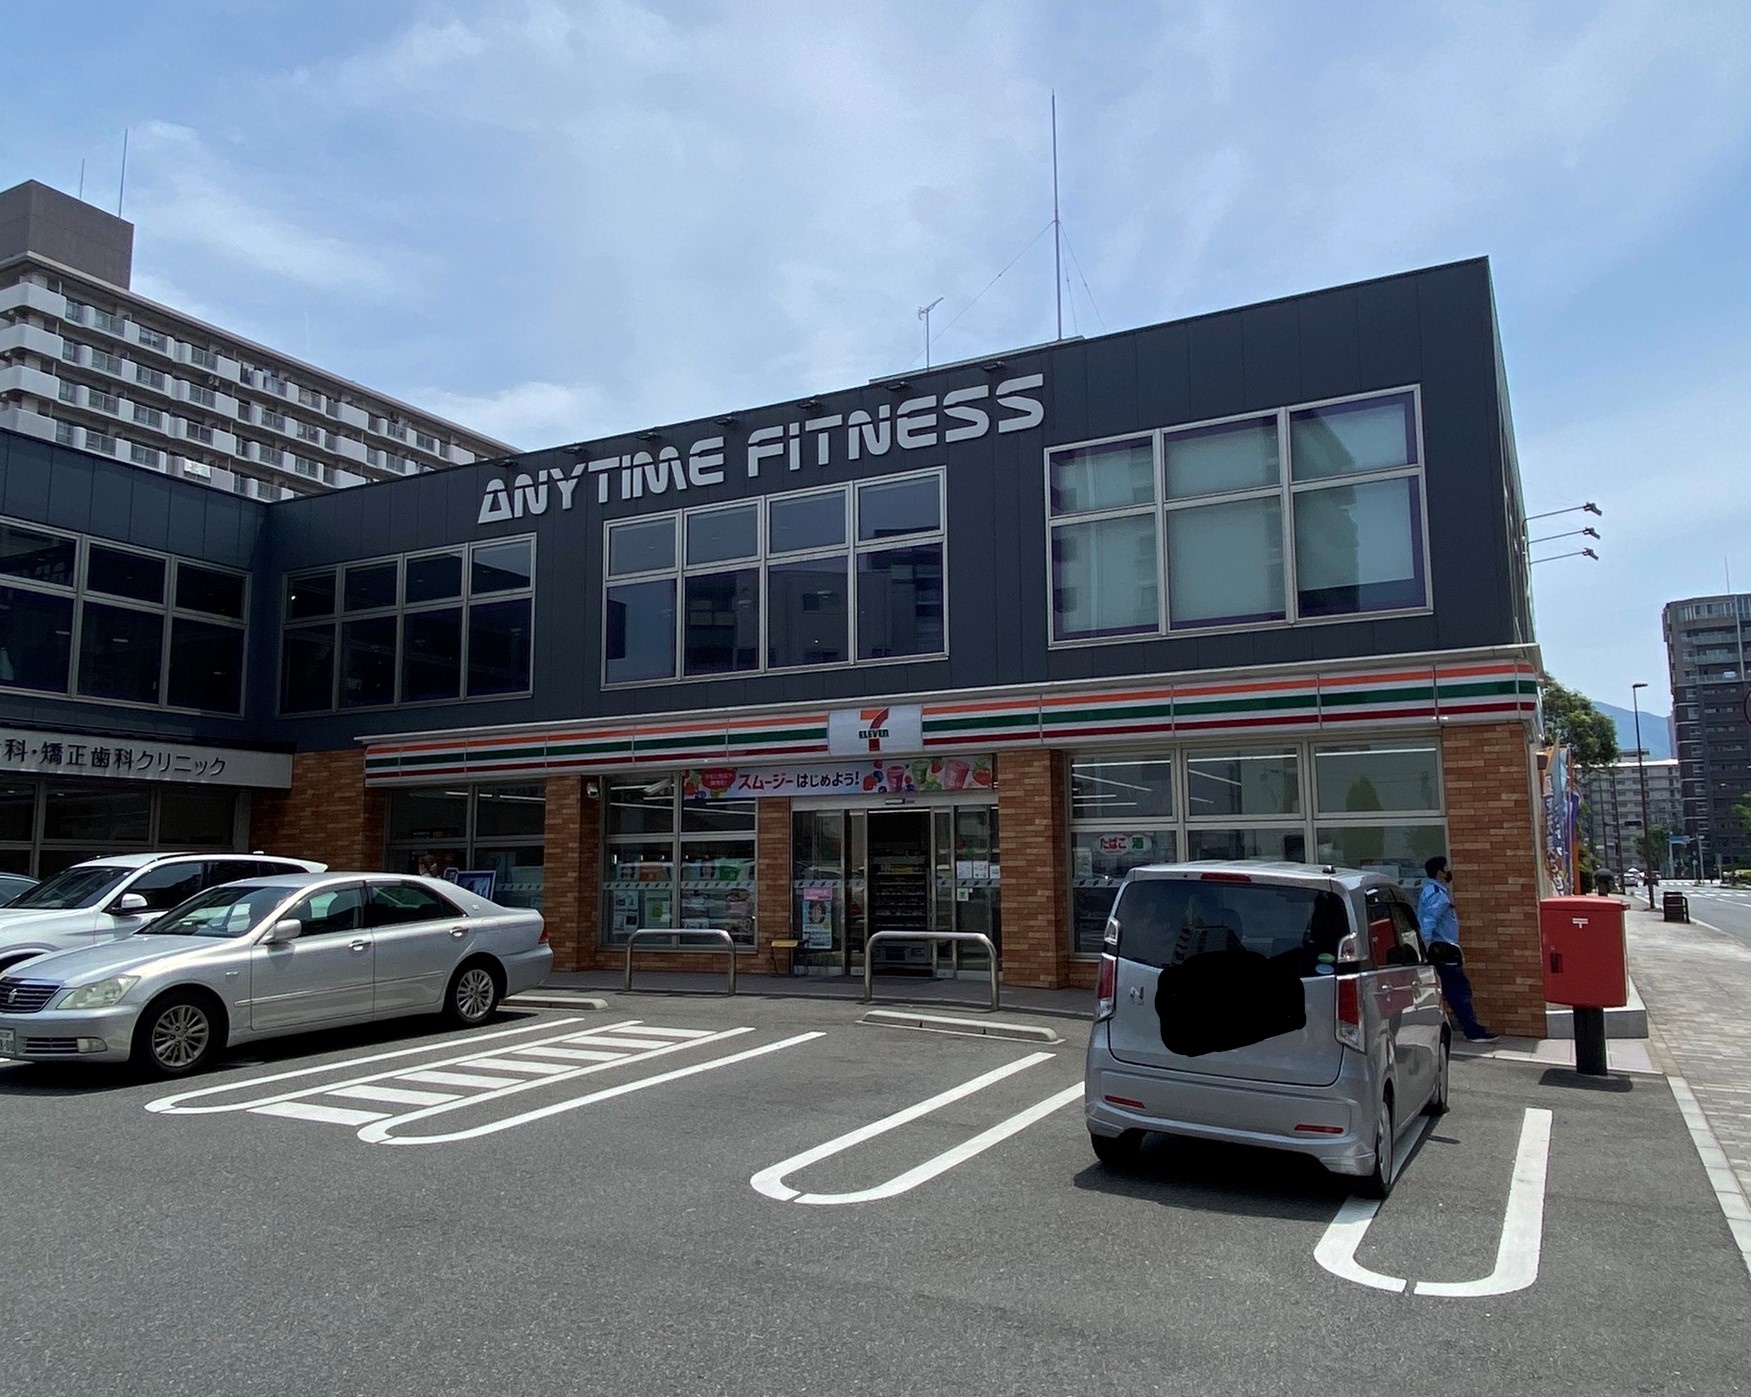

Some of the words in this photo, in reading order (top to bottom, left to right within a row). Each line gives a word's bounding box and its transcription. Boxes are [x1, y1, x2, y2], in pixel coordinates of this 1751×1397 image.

[477, 436, 725, 524] ANYTIME
[747, 373, 1045, 478] FITNESS
[0, 738, 226, 776] 科・矯正歯科クリニック
